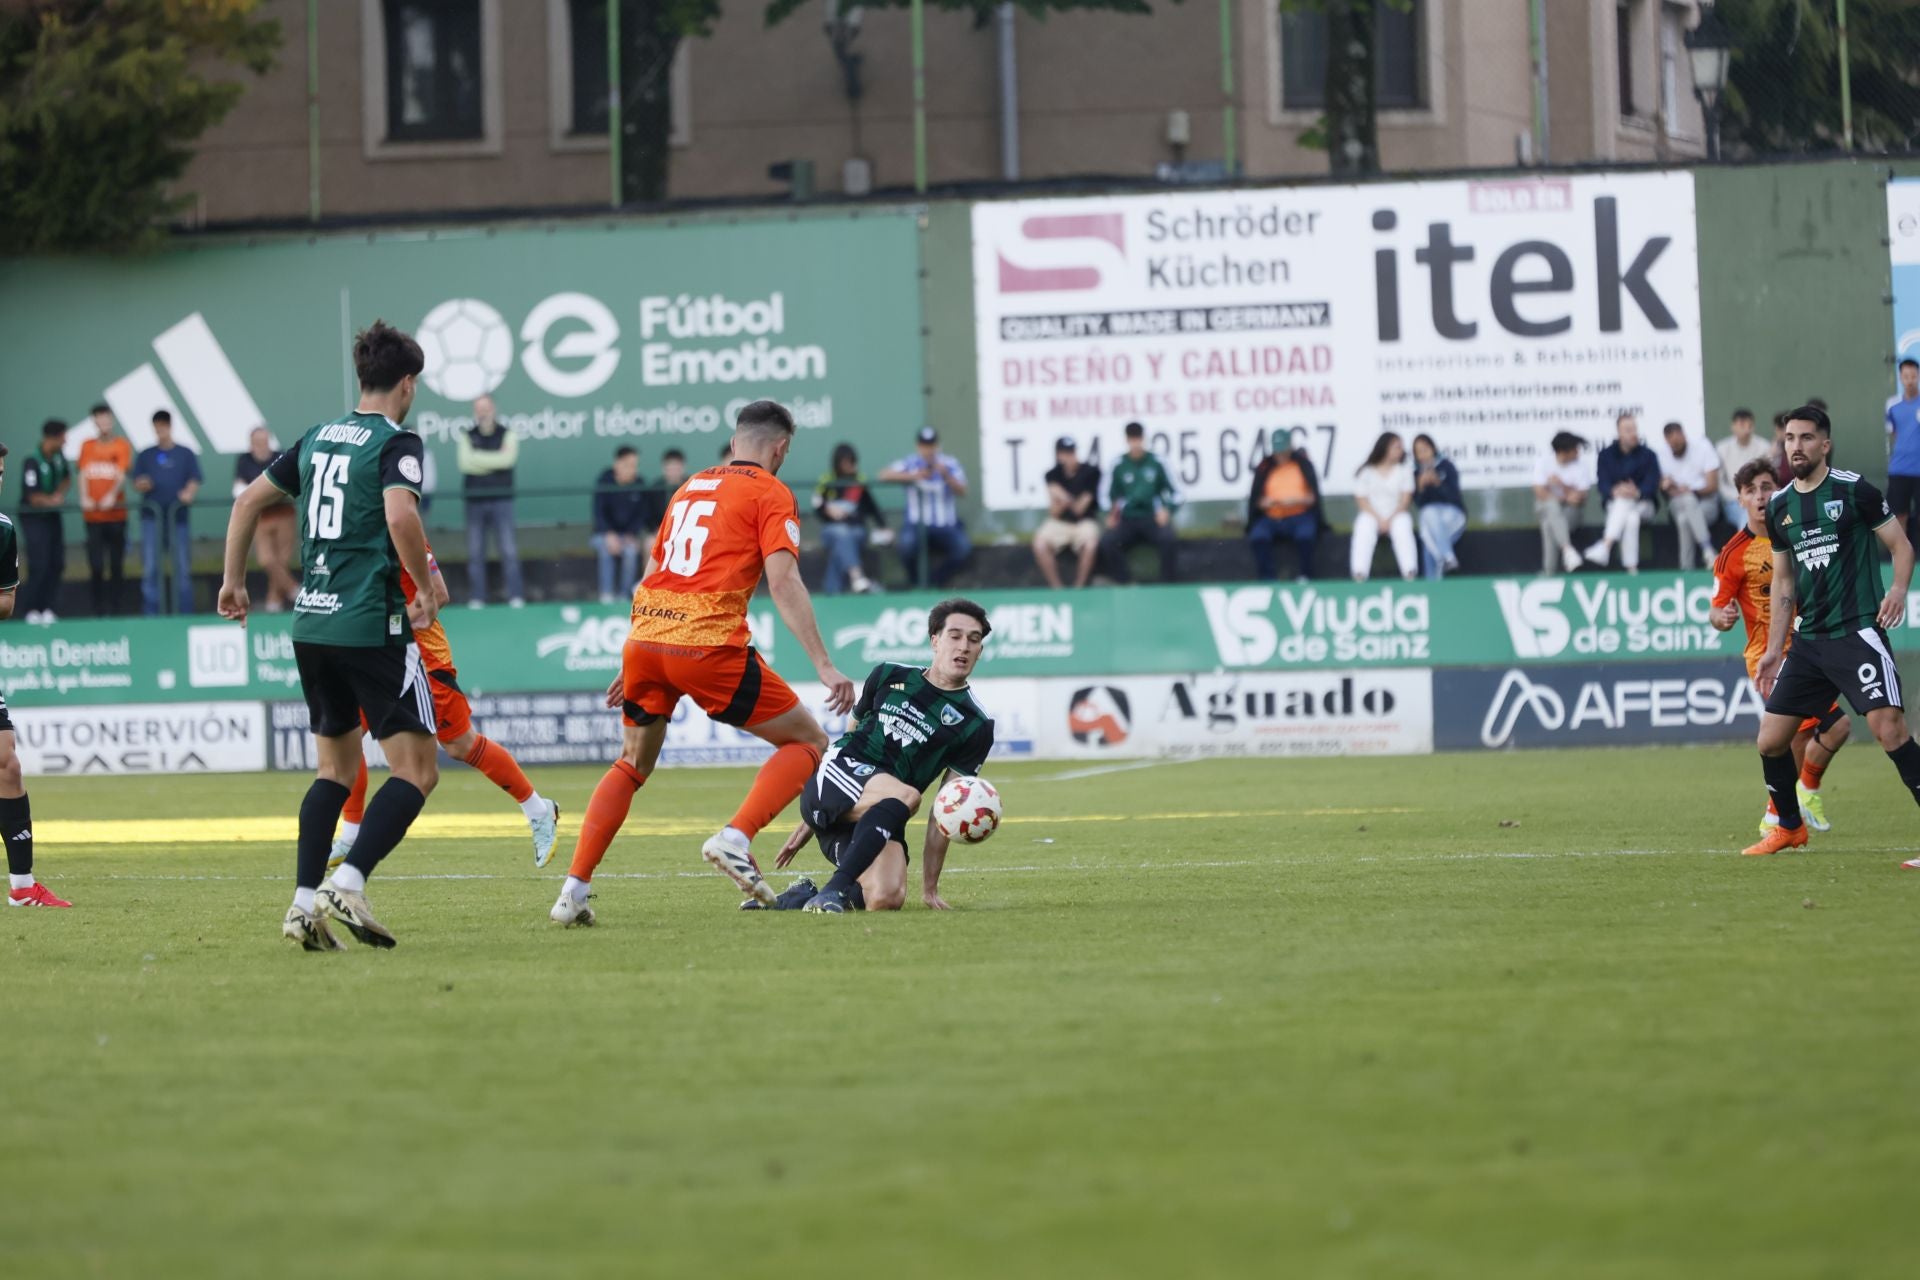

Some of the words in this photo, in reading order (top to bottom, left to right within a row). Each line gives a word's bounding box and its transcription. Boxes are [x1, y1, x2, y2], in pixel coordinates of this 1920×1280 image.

[1147, 205, 1321, 242] Schröder
[1148, 253, 1291, 290] Küchen
[1371, 195, 1679, 342] itek
[639, 292, 784, 340] Fútbol
[1110, 311, 1179, 335] MADE
[1182, 309, 1207, 331] IN
[641, 339, 827, 386] Emotion
[1003, 350, 1132, 387] DISEÑO
[1147, 353, 1167, 378] Y
[1182, 345, 1333, 377] CALIDAD
[1514, 352, 1528, 366] &
[1004, 397, 1038, 421] EN
[1050, 391, 1178, 419] MUEBLES
[1190, 389, 1222, 412] DE
[1235, 385, 1337, 411] COCINA
[1379, 379, 1622, 402] www.itekinteriorismo.com
[417, 404, 587, 444] Proedor
[595, 399, 720, 438] técnico
[724, 394, 832, 430] Oial
[308, 452, 351, 540] 15
[661, 500, 717, 577] 16
[632, 605, 688, 622] VALCARCE
[1279, 587, 1430, 635] Viuda
[1573, 578, 1715, 627] Viuda
[864, 603, 1074, 649] AGMEN
[1573, 622, 1620, 653] de
[1626, 621, 1722, 653] Sainz
[0, 638, 48, 669] ban
[51, 636, 131, 667] Dental
[254, 632, 303, 660] Urb
[1279, 634, 1328, 662] de
[1333, 632, 1431, 662] Sainz
[1160, 676, 1397, 734] Aguado
[1570, 679, 1765, 729] AFESA
[42, 751, 207, 773] DACIA
